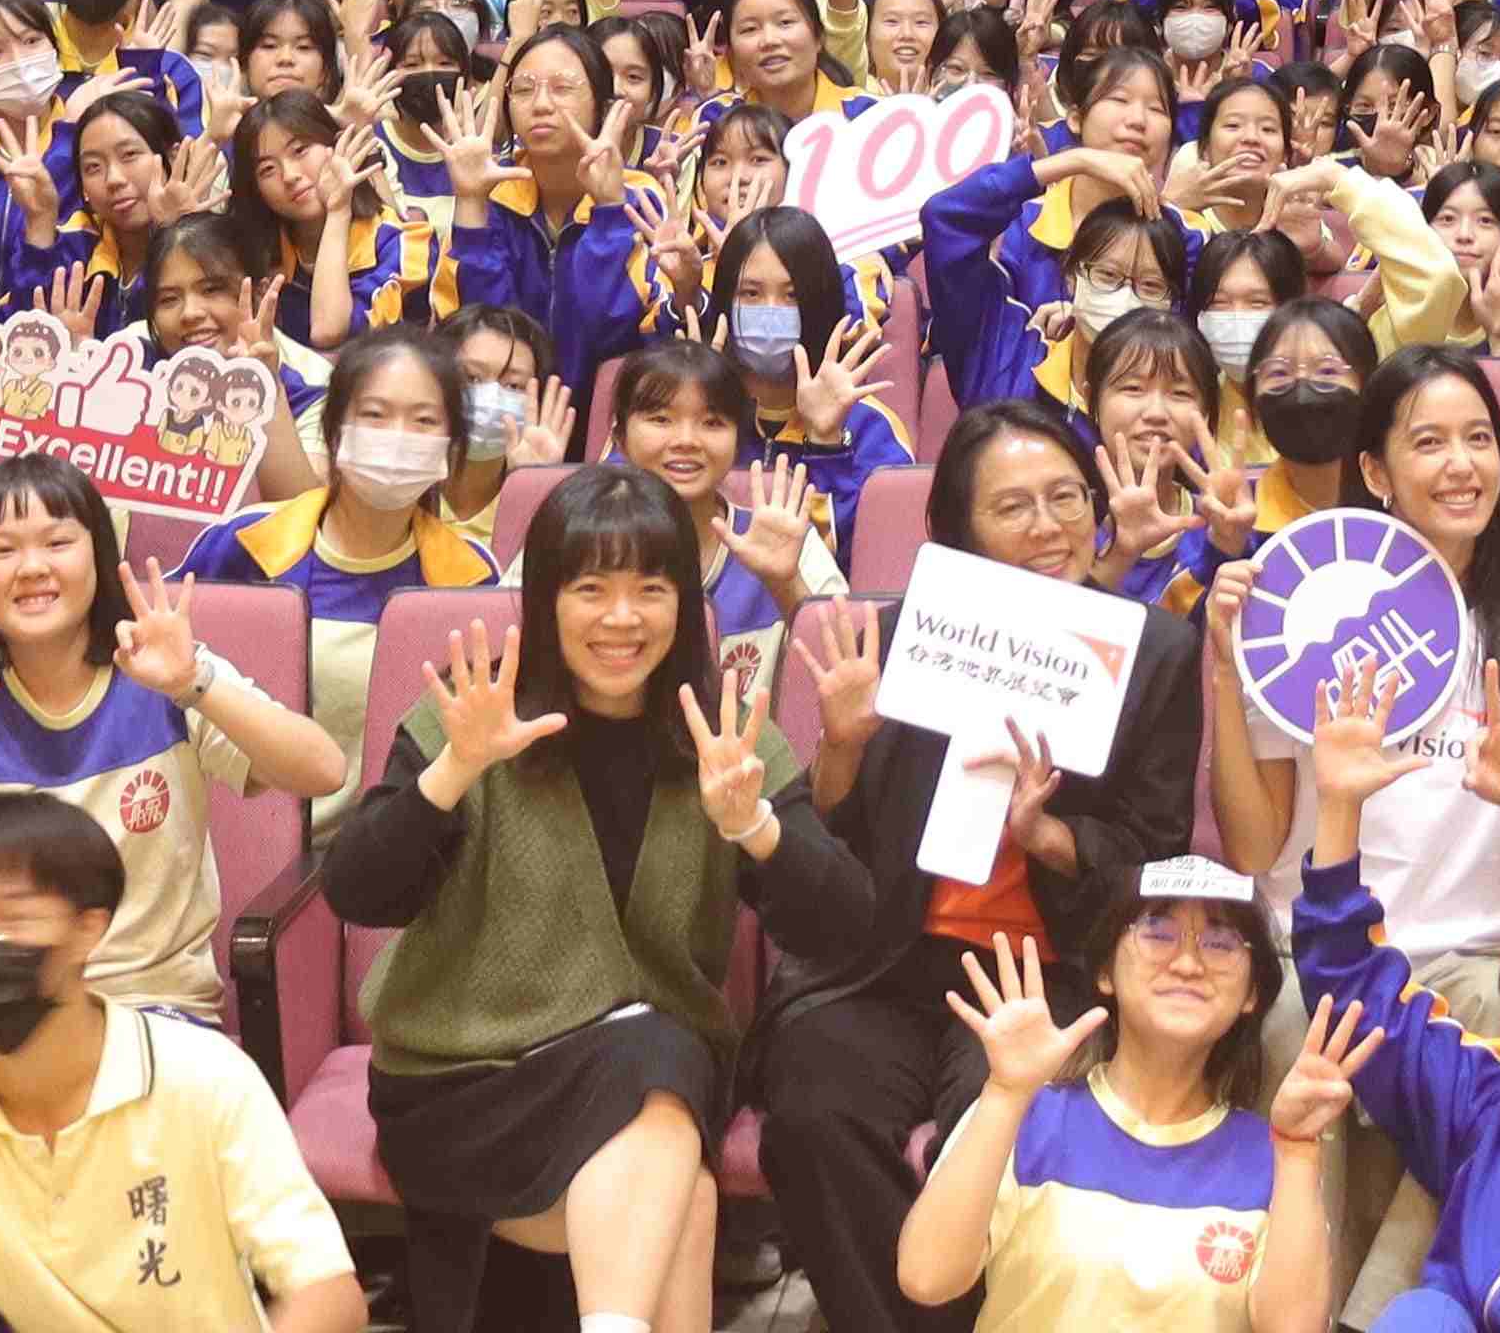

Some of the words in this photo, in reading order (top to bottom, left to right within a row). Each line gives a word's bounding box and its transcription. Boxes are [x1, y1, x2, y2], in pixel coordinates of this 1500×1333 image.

[799, 93, 1002, 214] 100
[916, 609, 999, 653] World
[1008, 636, 1089, 680] Vision
[126, 1175, 181, 1288] 曙光
